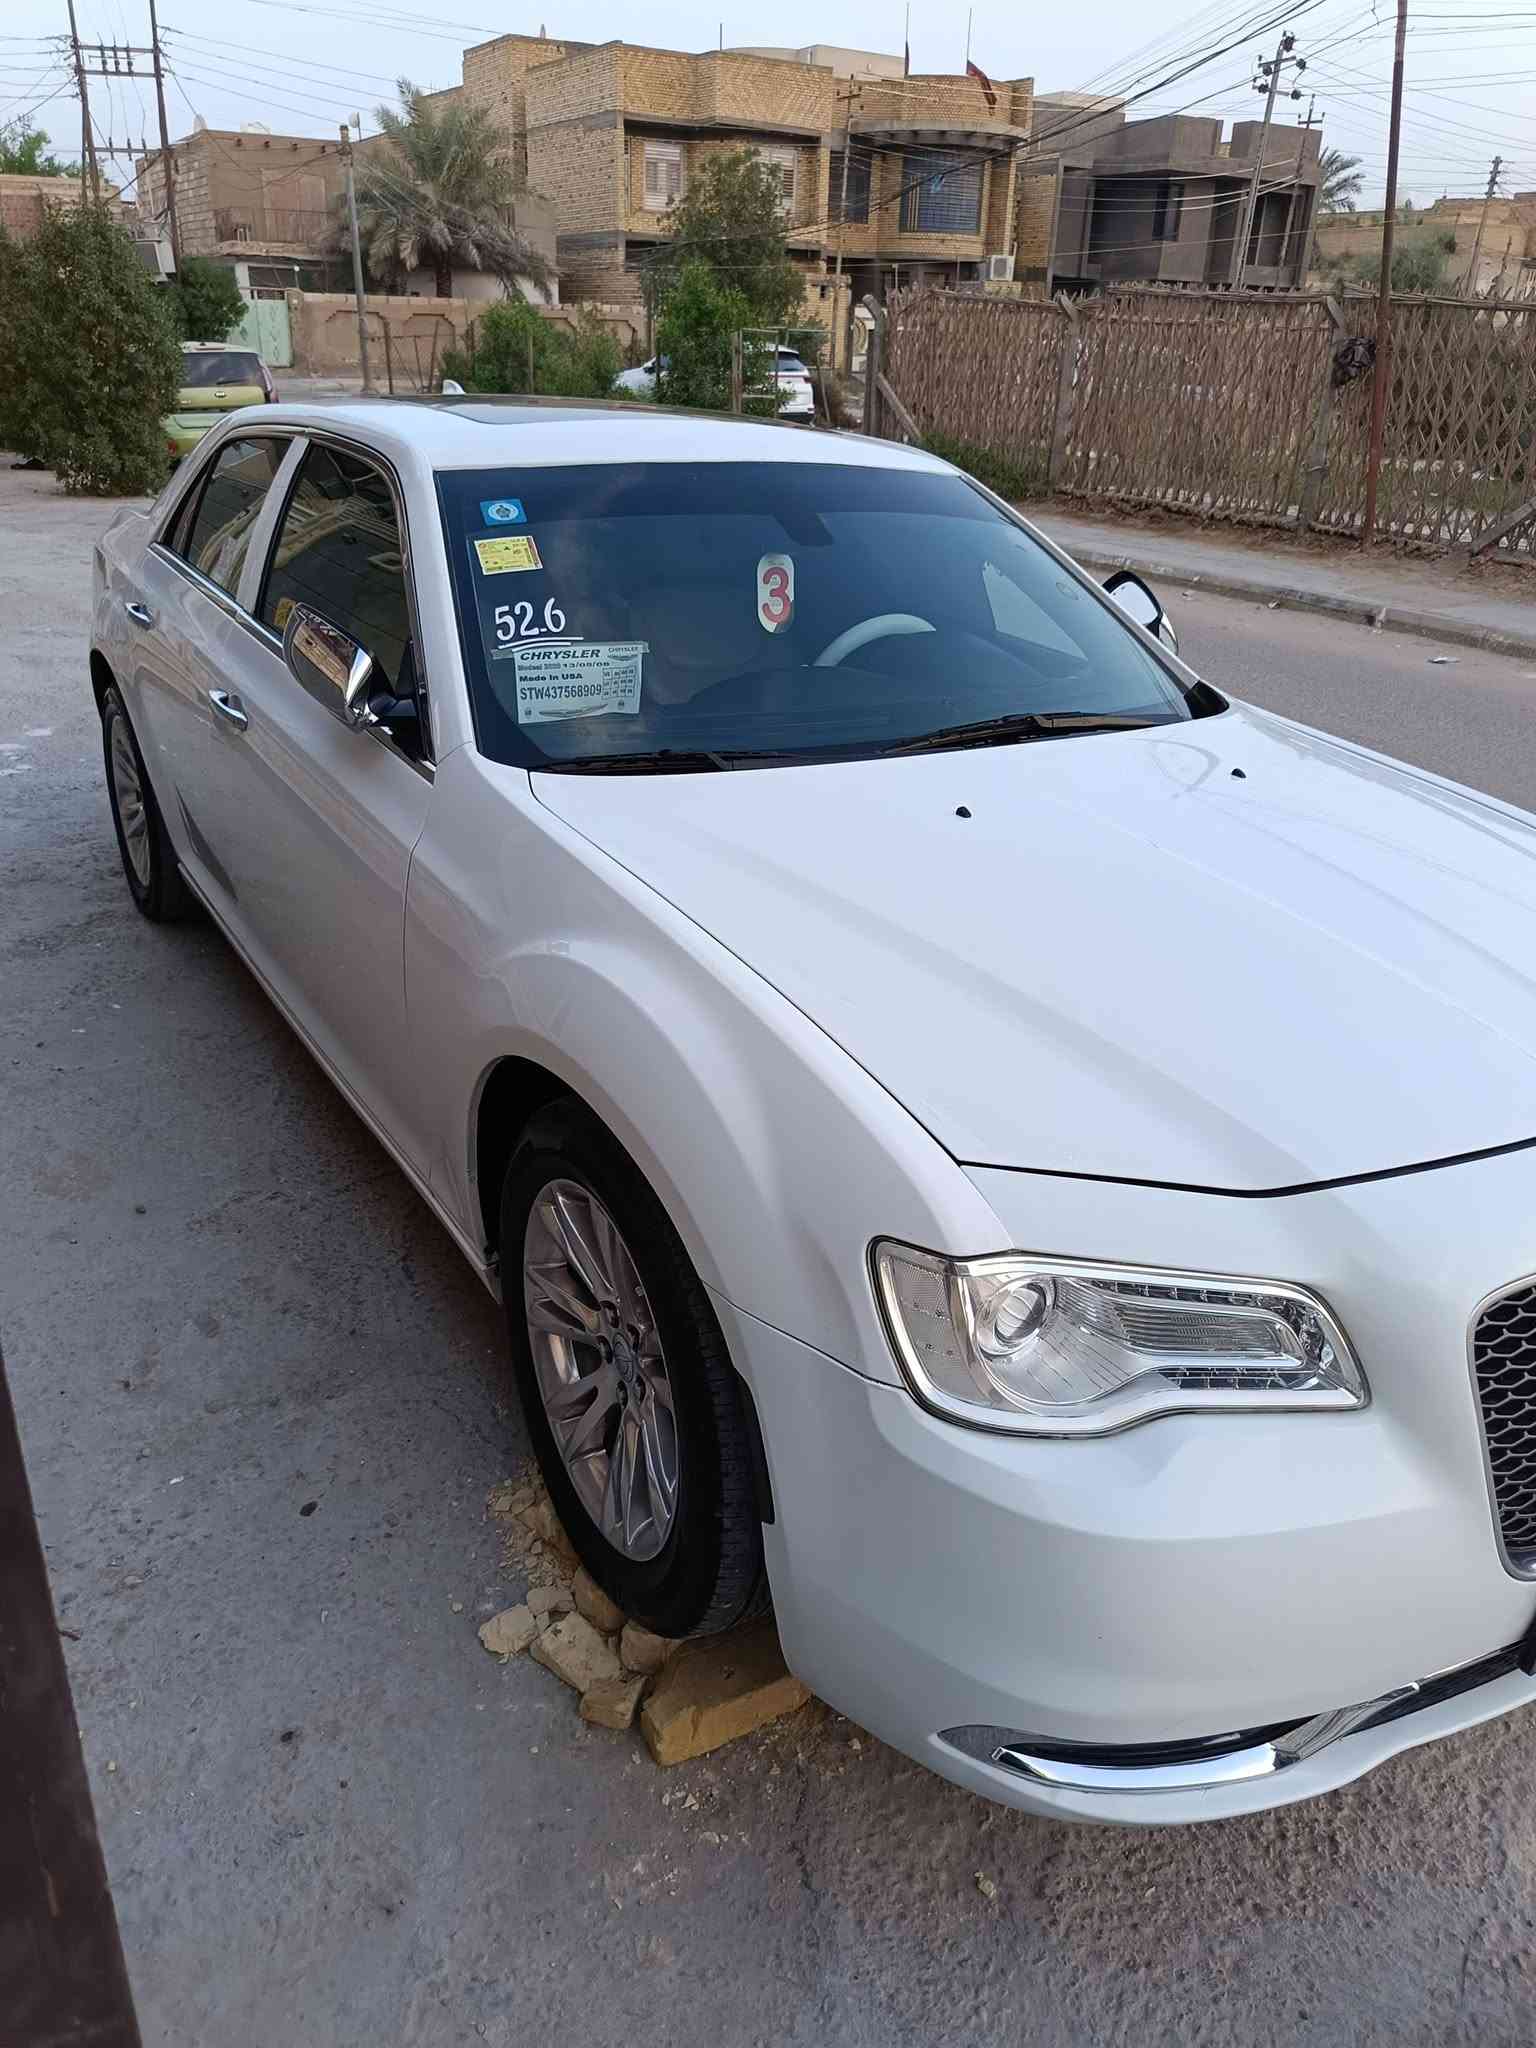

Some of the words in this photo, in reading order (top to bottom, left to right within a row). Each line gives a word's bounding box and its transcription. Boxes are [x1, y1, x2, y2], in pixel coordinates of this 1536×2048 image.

[763, 567, 792, 624] 3
[520, 649, 601, 661] CHRYSLER
[520, 673, 547, 682] Made
[562, 671, 583, 680] USA
[520, 684, 602, 700] STW437568909
